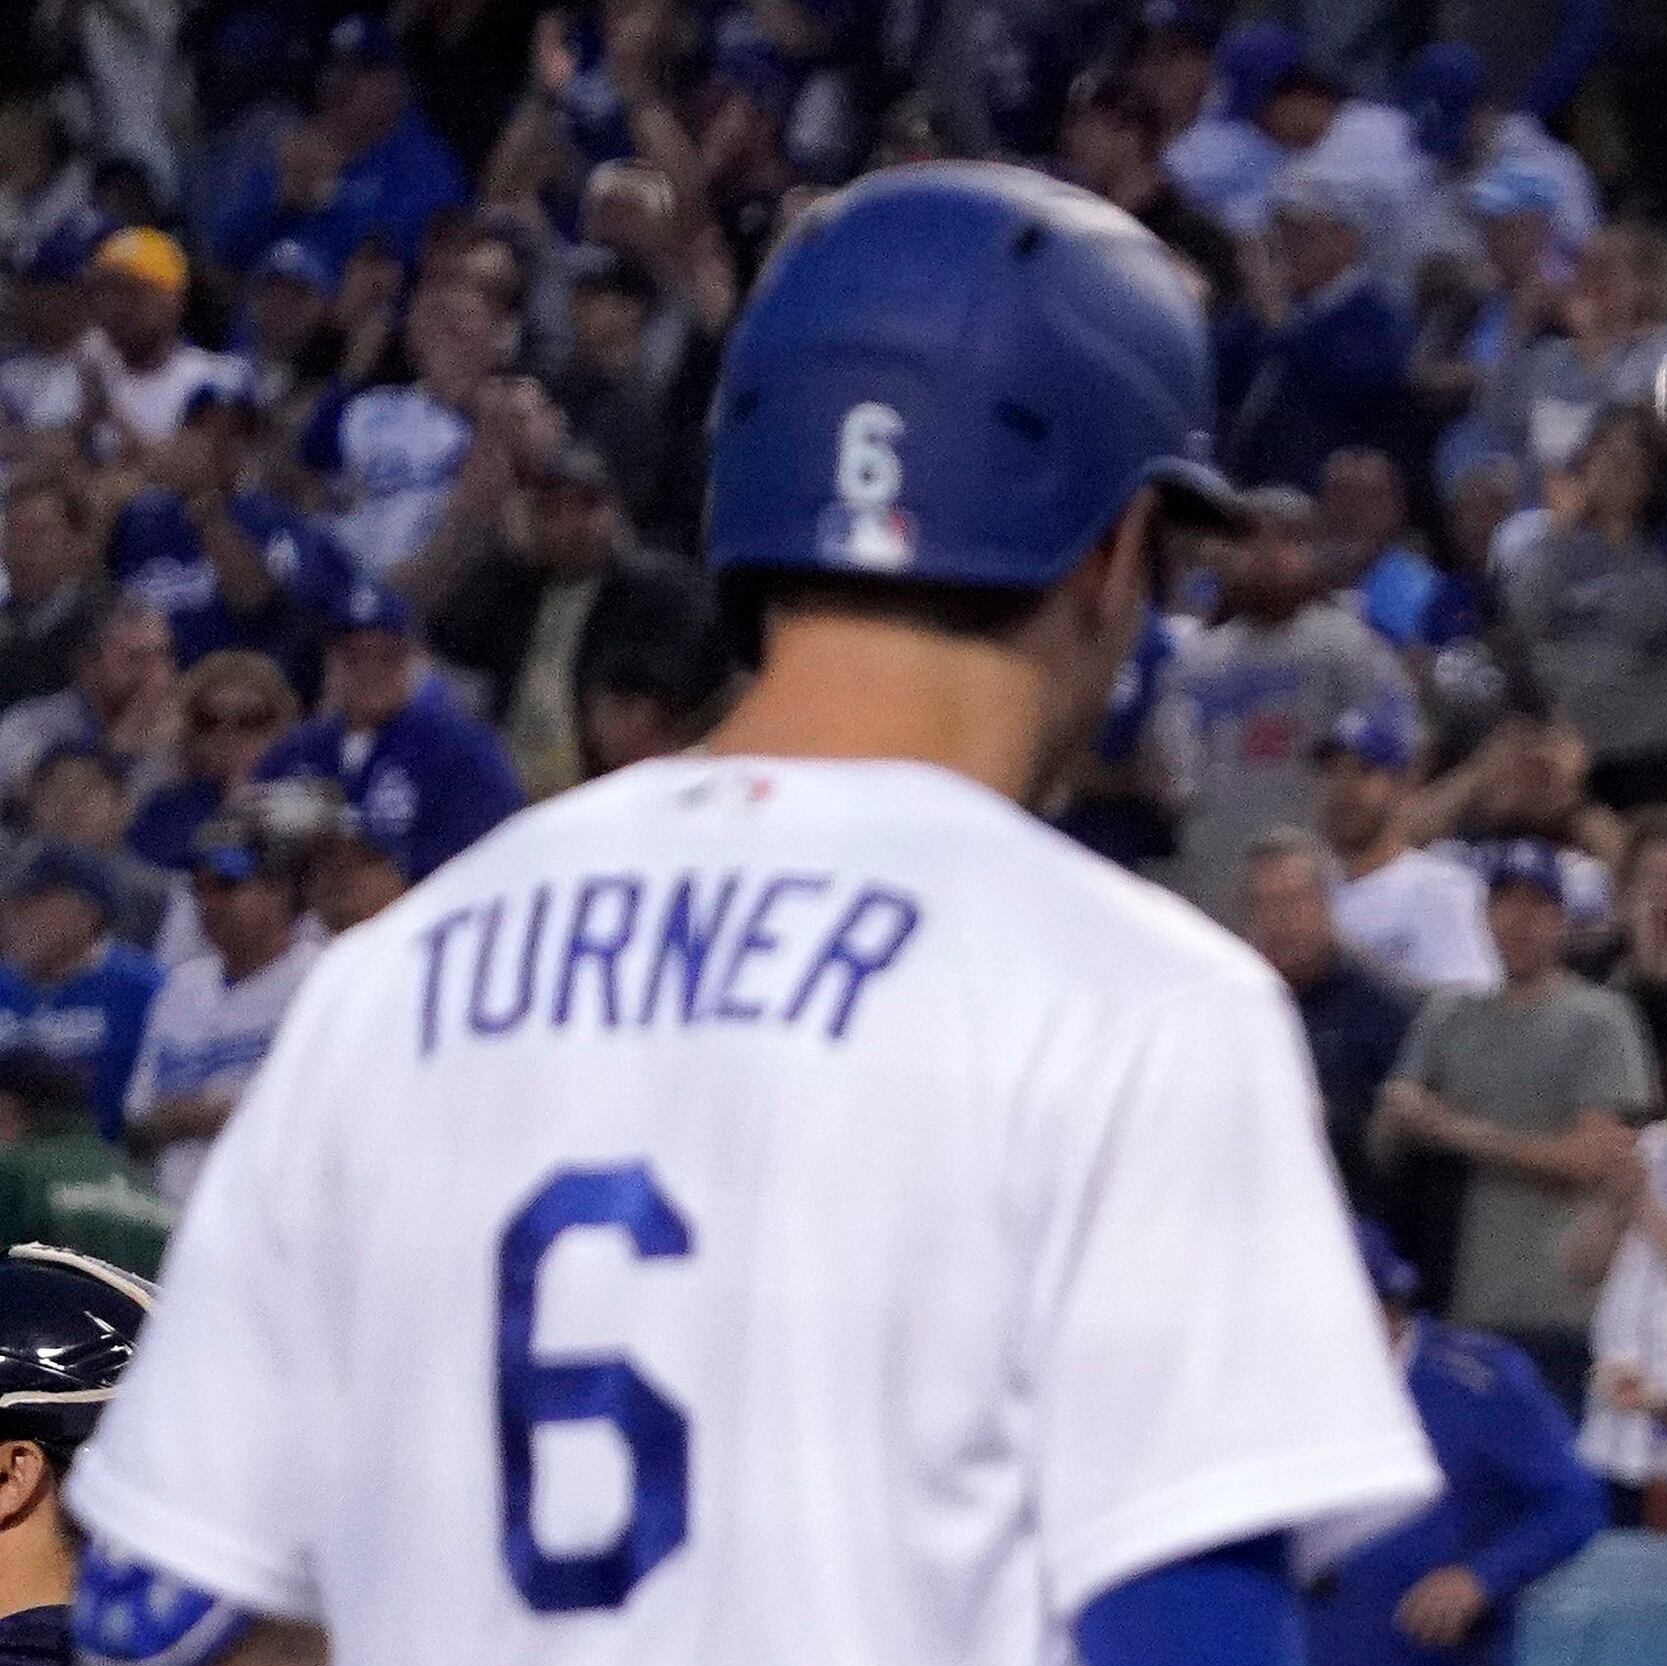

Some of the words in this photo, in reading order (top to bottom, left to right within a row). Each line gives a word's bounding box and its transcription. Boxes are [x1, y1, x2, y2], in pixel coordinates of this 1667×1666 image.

[837, 401, 904, 503] 6
[413, 864, 921, 1064] TURNER
[496, 1156, 694, 1612] 6
